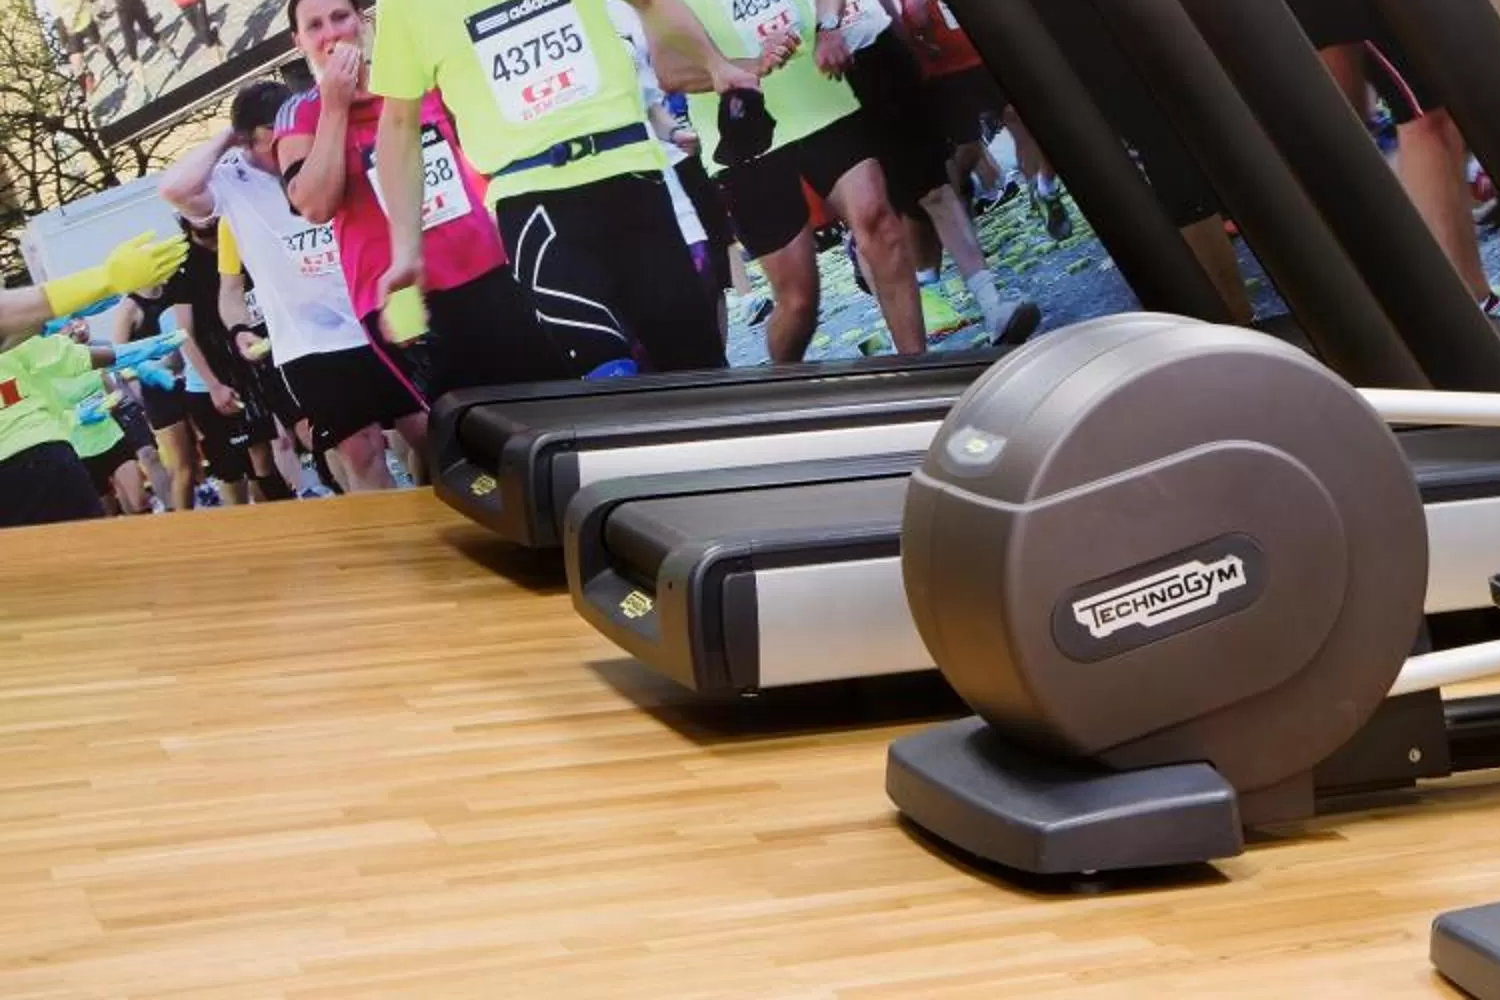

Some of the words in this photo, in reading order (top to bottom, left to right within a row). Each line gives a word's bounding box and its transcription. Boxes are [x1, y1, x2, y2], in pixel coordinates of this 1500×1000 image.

[492, 24, 583, 81] 43755
[521, 67, 575, 104] GT
[1079, 563, 1237, 629] TECHNOGYM
